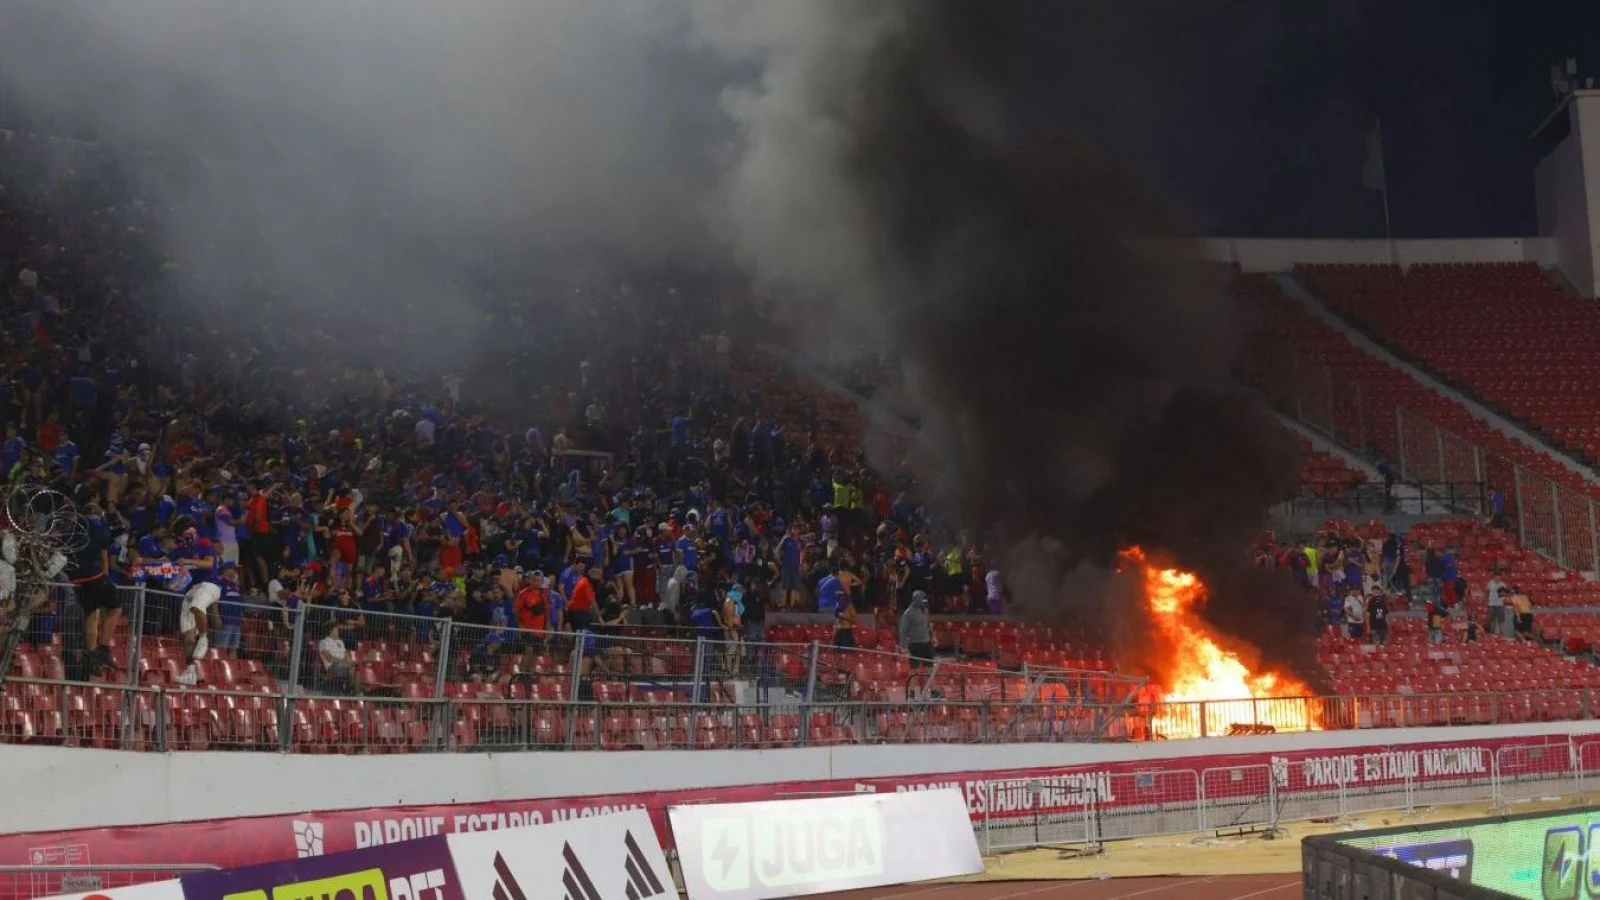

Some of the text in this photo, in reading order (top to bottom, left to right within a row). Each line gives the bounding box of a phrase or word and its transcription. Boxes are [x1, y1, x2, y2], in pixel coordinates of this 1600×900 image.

[1304, 746, 1486, 786] PARQUE ESTADIO NACIONAL
[965, 770, 1116, 814] ESTADIO NACIONAL
[760, 816, 876, 878] JUGA
